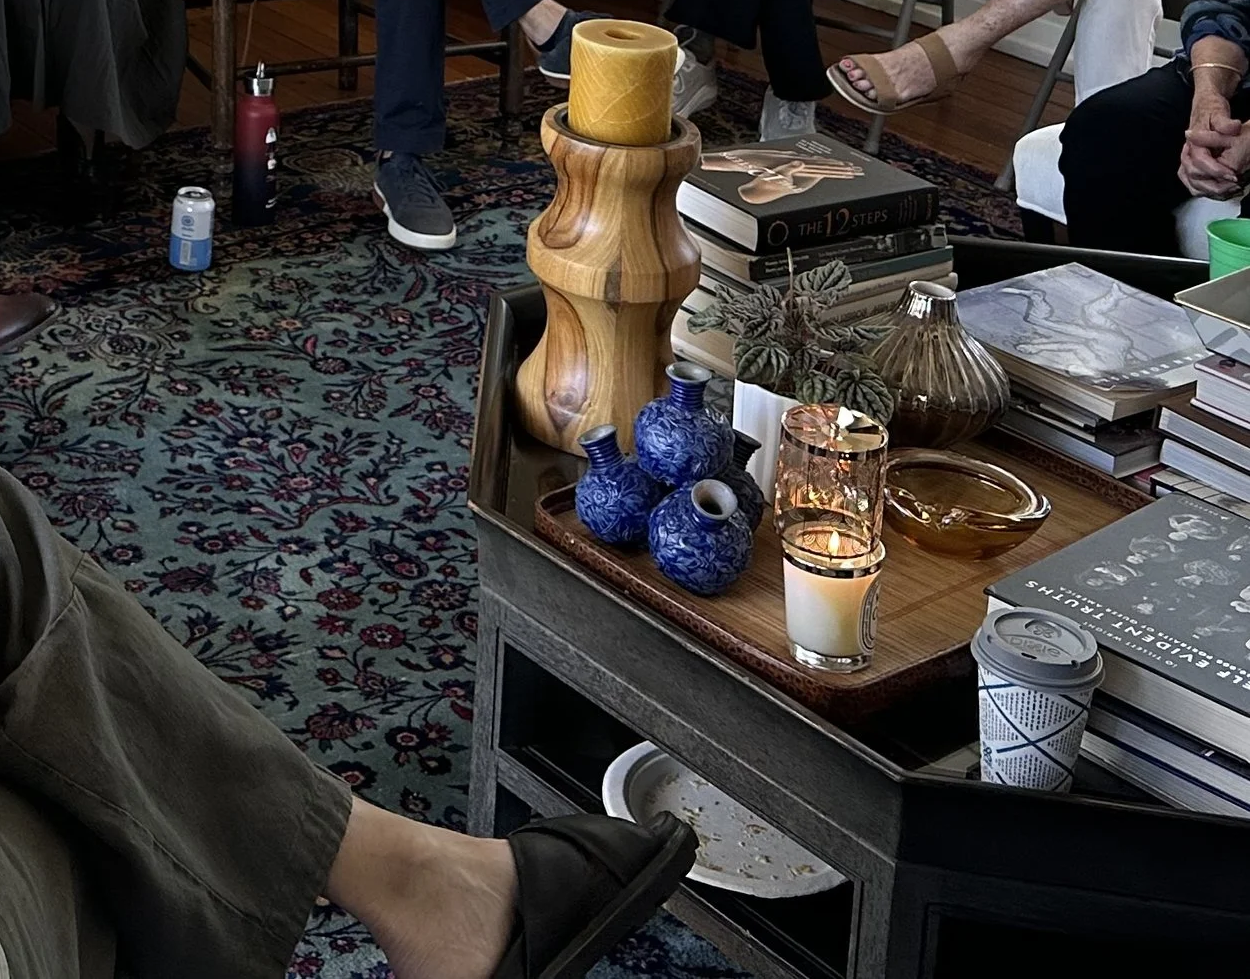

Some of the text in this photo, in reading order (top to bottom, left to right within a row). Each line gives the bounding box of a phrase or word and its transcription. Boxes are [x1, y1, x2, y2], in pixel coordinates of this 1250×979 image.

[799, 208, 889, 237] THE 12 STEPS
[1024, 580, 1250, 691] ELF EVIDENT TRUTHS
[1083, 621, 1122, 642] WRIGHT
[1140, 624, 1155, 633] OF
[1157, 632, 1214, 661] PORTRAITS
